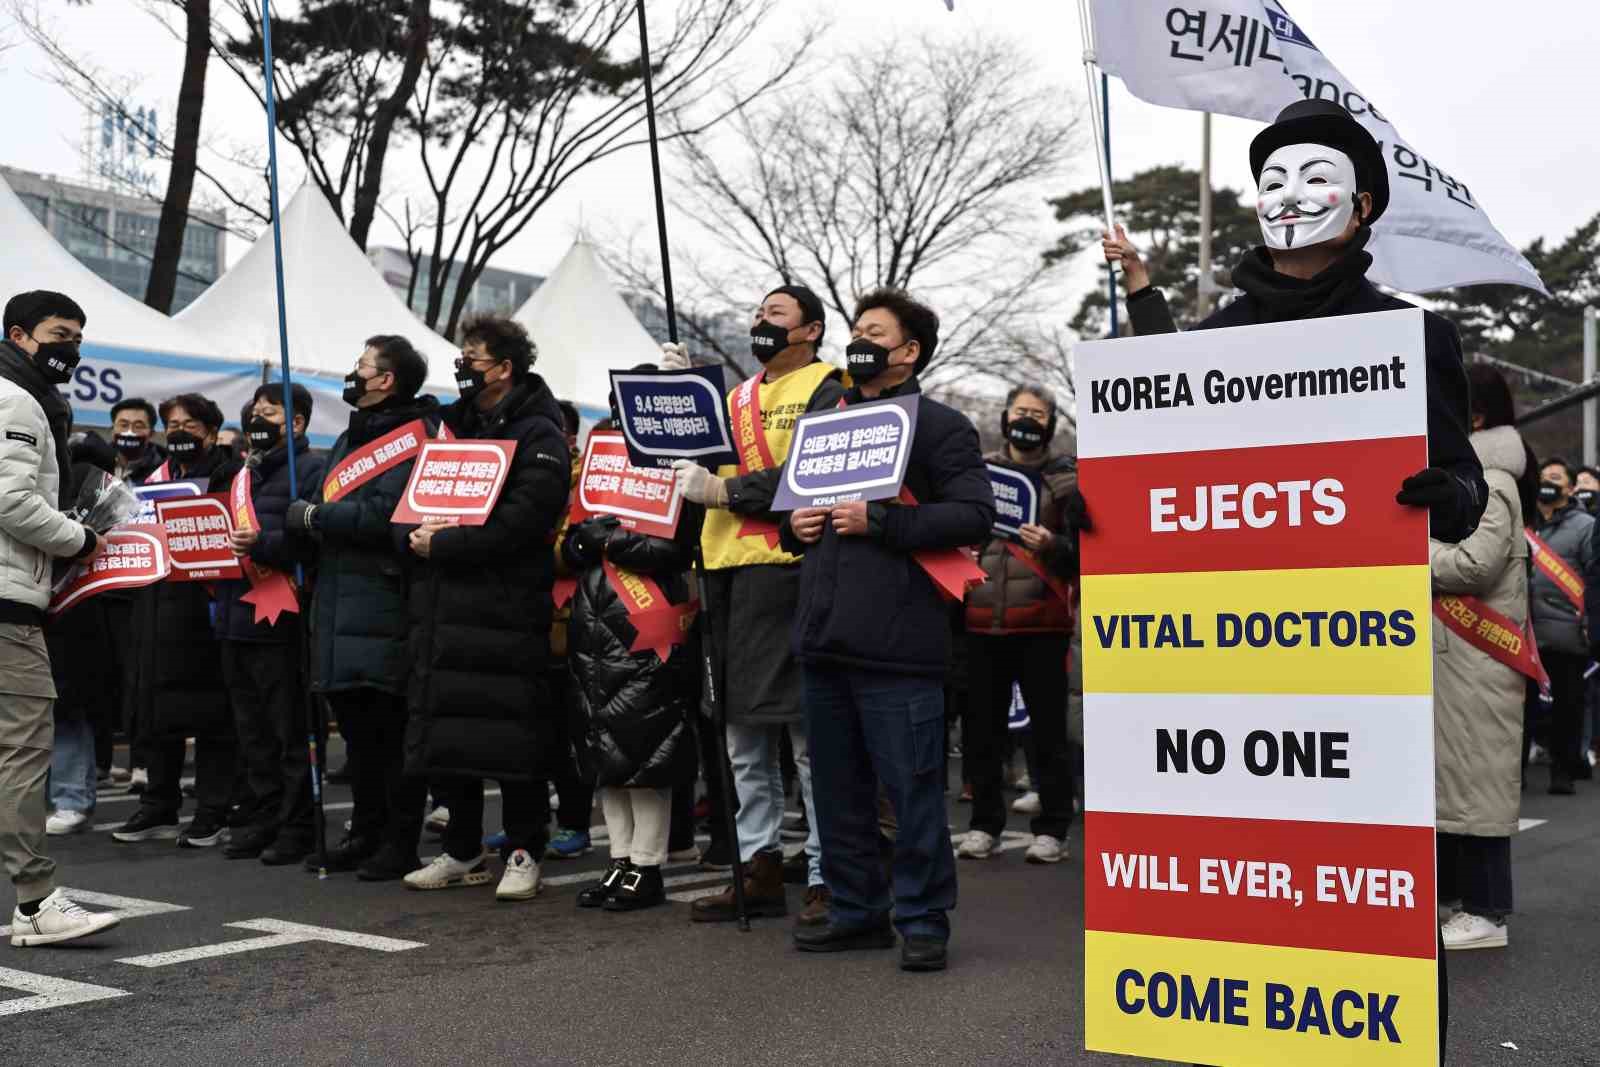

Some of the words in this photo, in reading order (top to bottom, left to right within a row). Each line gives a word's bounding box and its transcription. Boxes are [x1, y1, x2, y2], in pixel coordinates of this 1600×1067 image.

[1091, 373, 1194, 414] KOREA
[1203, 355, 1406, 405] Government
[801, 430, 850, 455] 의료계와
[850, 423, 900, 449] 합의없는
[423, 461, 460, 478] 준비안된
[459, 462, 499, 479] 의대증원
[589, 454, 627, 472] 준비안된
[796, 453, 845, 476] 의대증원
[847, 445, 897, 471] 결사반대
[416, 480, 454, 496] 의학교육
[585, 475, 620, 493] 의학교육
[1150, 478, 1346, 532] EJECTS
[1093, 613, 1204, 649] VITAL
[1216, 609, 1416, 647] DOCTORS
[1156, 728, 1225, 774] NO
[1243, 730, 1350, 778] ONE
[1101, 852, 1189, 892] WILL
[1199, 858, 1303, 907] EVER,
[1316, 865, 1415, 908] EVER
[1115, 968, 1249, 1026] COME
[1265, 982, 1402, 1043] BACK
